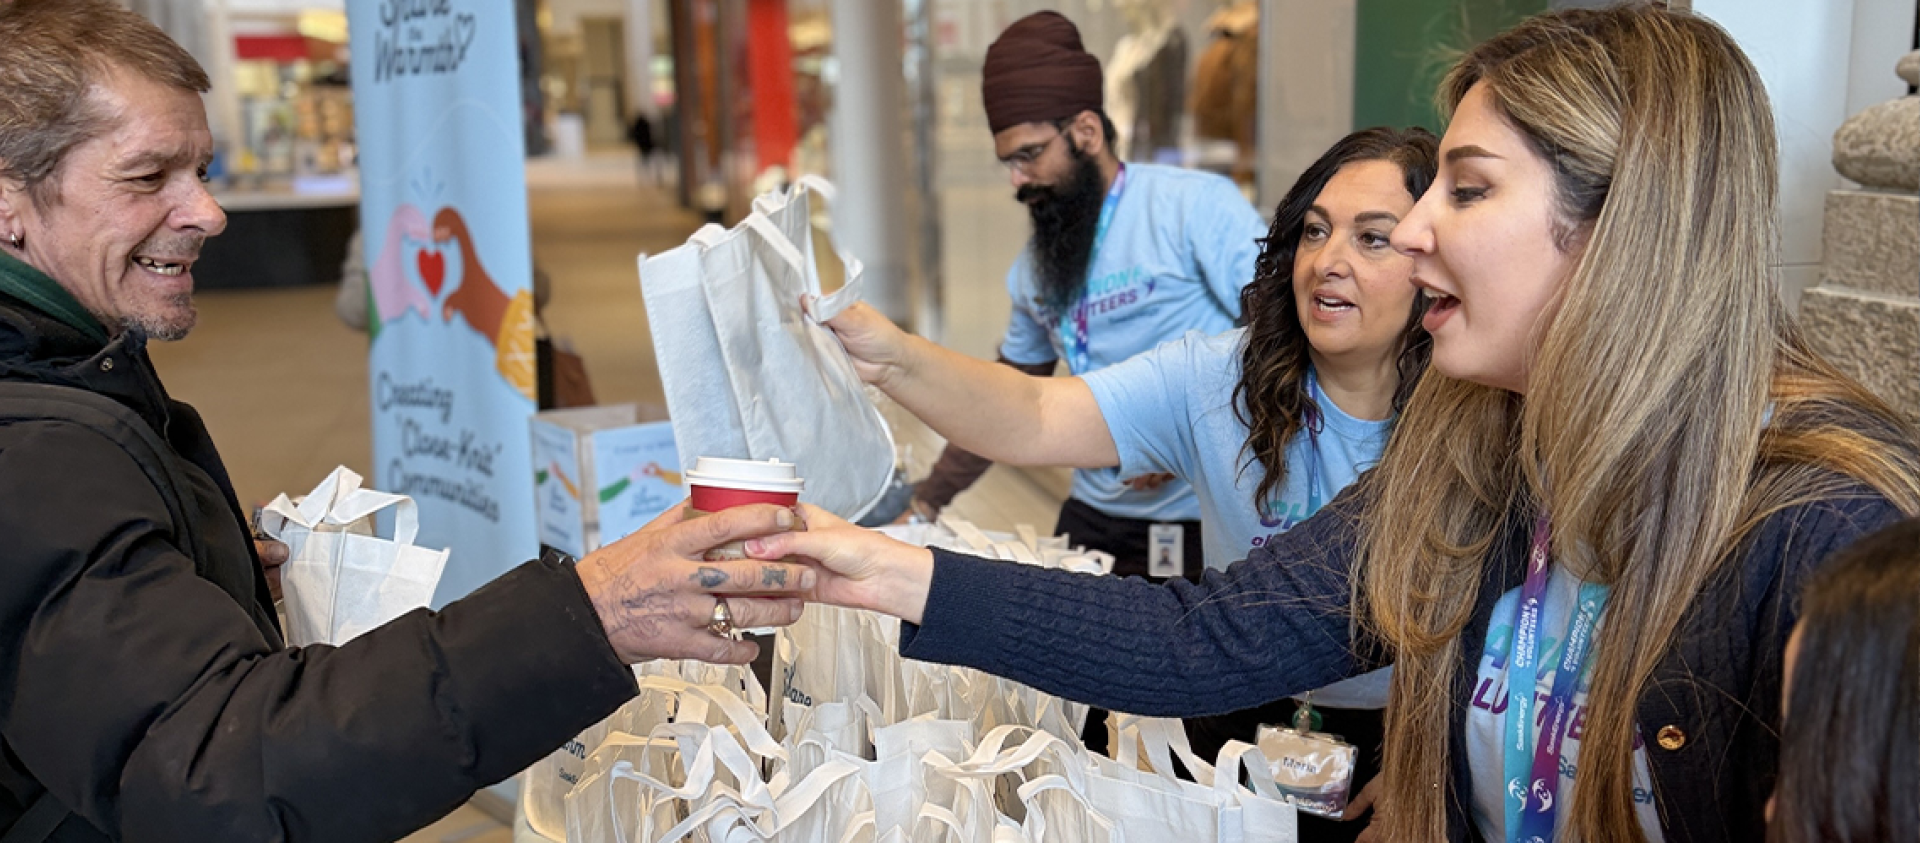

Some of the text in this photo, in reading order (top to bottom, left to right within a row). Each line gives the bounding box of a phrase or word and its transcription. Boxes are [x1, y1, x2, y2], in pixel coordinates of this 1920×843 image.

[375, 27, 458, 82] Warmth
[377, 371, 453, 424] Creating
[388, 458, 499, 522] Communities
[1515, 611, 1531, 668] CHAMPION
